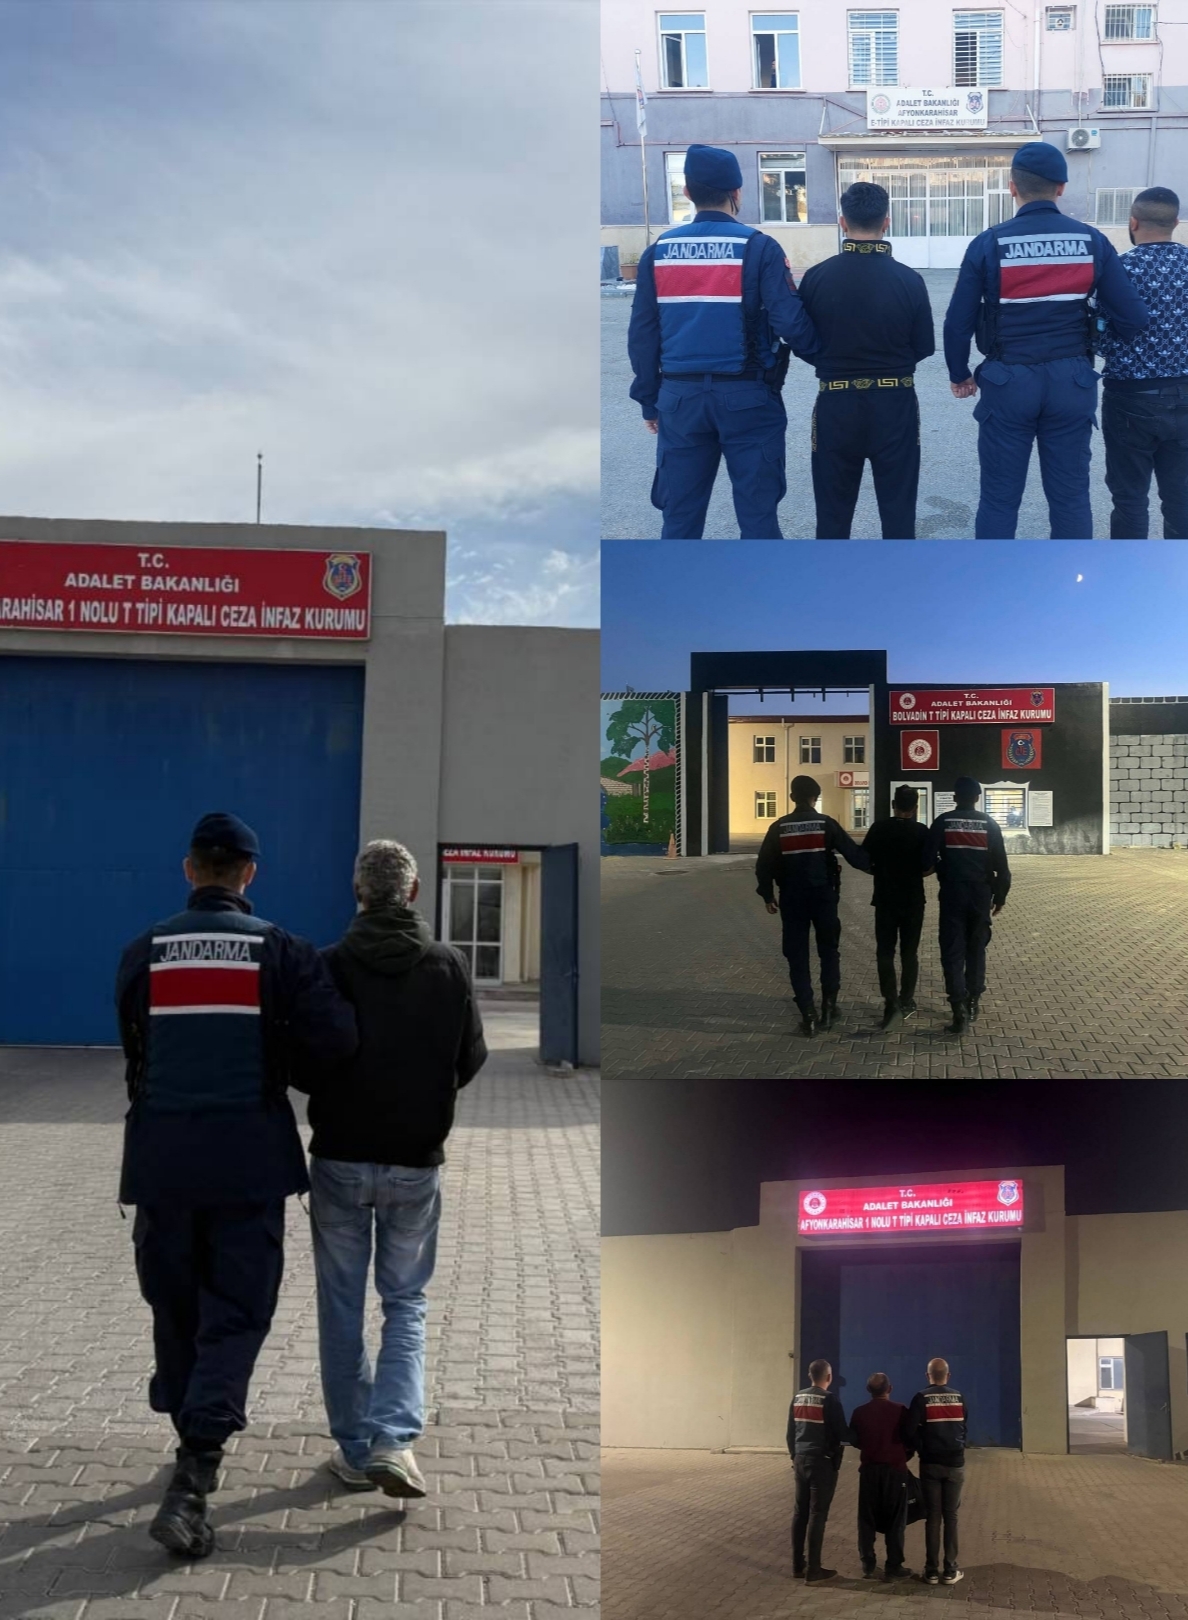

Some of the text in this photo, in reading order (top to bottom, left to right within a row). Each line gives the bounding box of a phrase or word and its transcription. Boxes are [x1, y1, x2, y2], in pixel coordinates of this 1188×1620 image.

[896, 98, 960, 107] ADALET BAKANLIĞI
[898, 108, 958, 117] AFYONKARAHİSAR
[916, 119, 933, 127] CEZA
[935, 117, 954, 126] İNFAZ
[663, 243, 734, 259] JANDARMA
[1005, 241, 1088, 259] JANDARMA
[138, 553, 169, 568] T.C.
[64, 573, 239, 593] ADALET BAKANLIĞI
[0, 594, 366, 631] RAHİSAR 1 NOLU T TİPİ KAPALI CEZA İNFAZ KURUMU
[966, 699, 1012, 707] BAKANLIĞI
[892, 708, 1052, 721] BOLVADİN T TİPİ KAPALI CEZA İNFAZ KURUMU
[160, 940, 251, 962] JANDARMA
[899, 1189, 916, 1197] T.C.
[863, 1198, 953, 1211] ADALET BAKANLIĞI
[801, 1210, 1022, 1230] AFYONKARAHİSAR 1 NOLU T TİPİ KAPALI CEZA İNFAZ KURUMU
